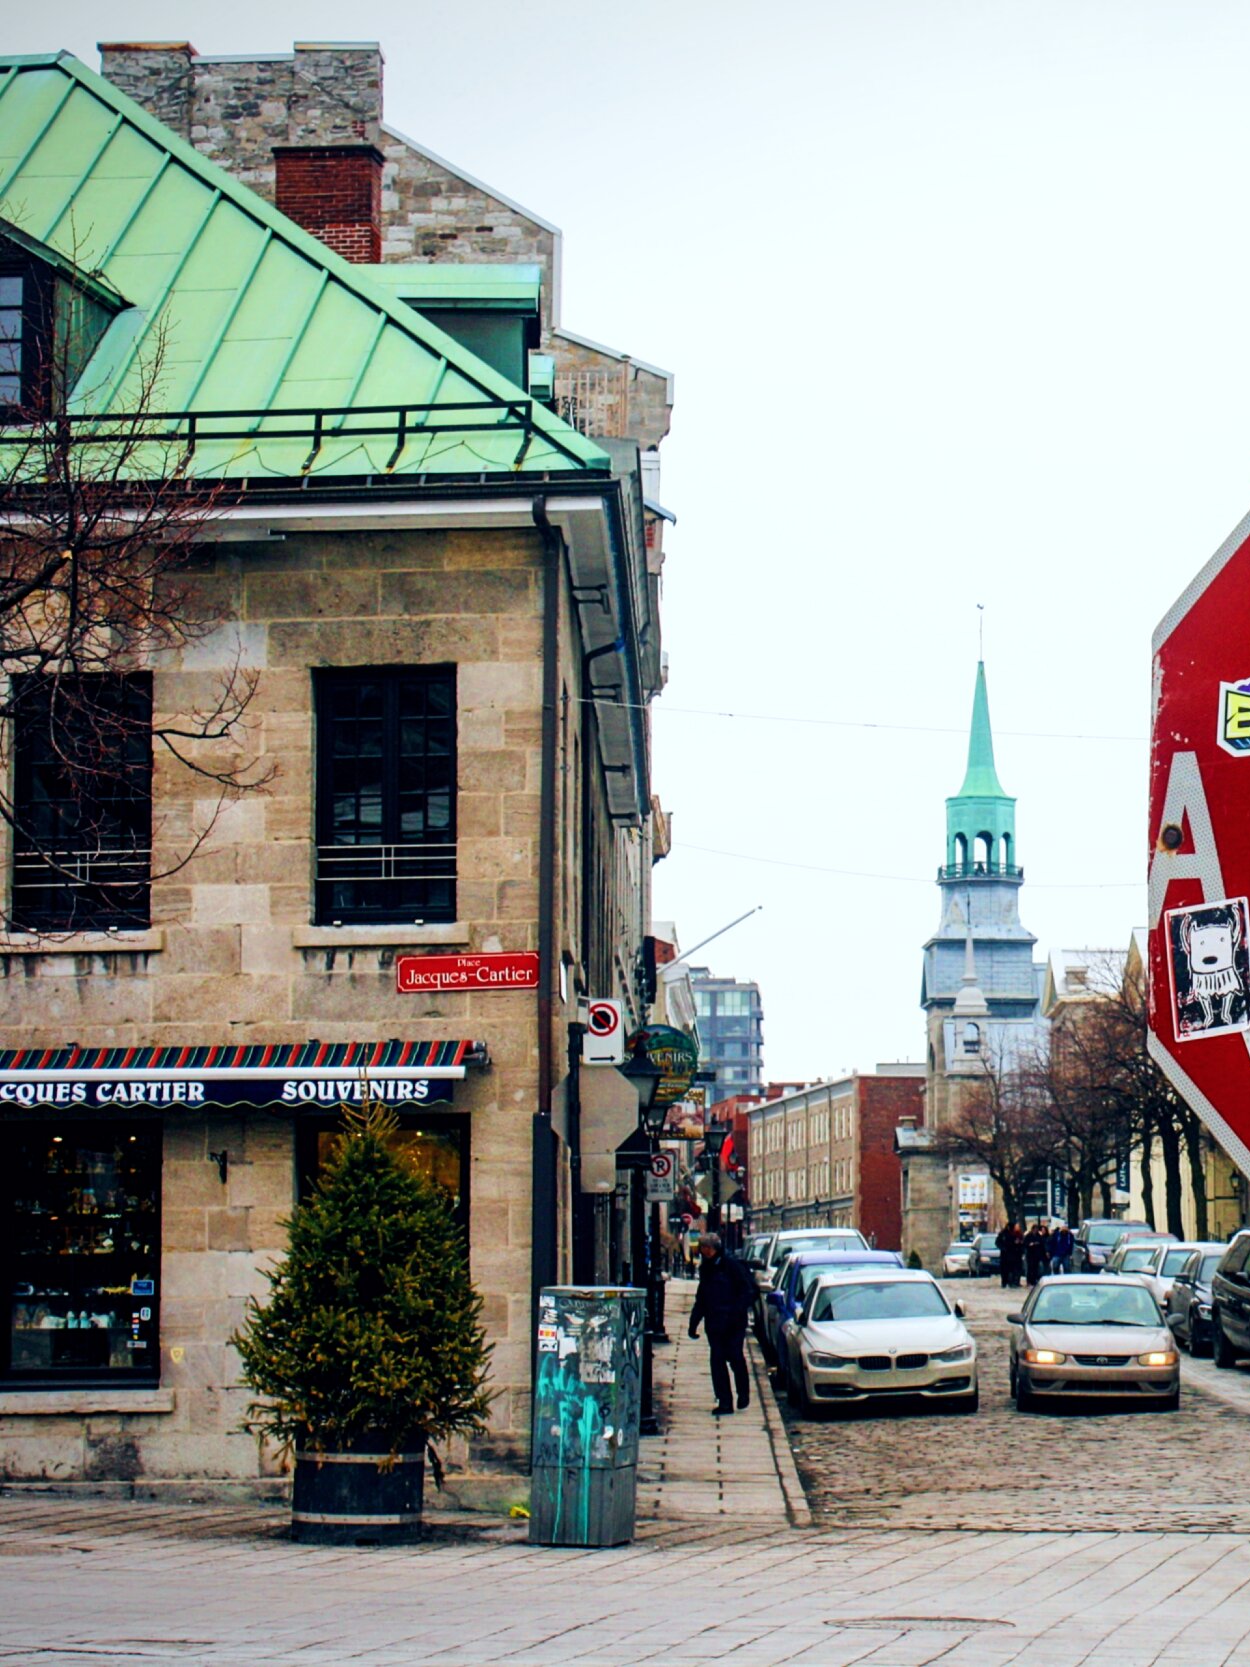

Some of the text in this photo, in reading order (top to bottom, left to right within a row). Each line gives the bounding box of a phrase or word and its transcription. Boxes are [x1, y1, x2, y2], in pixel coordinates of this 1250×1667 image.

[457, 958, 481, 967] Place
[406, 966, 533, 989] Jacques-Cartier
[96, 1082, 205, 1102] CARTIER
[281, 1079, 429, 1101] SOUVENIRS
